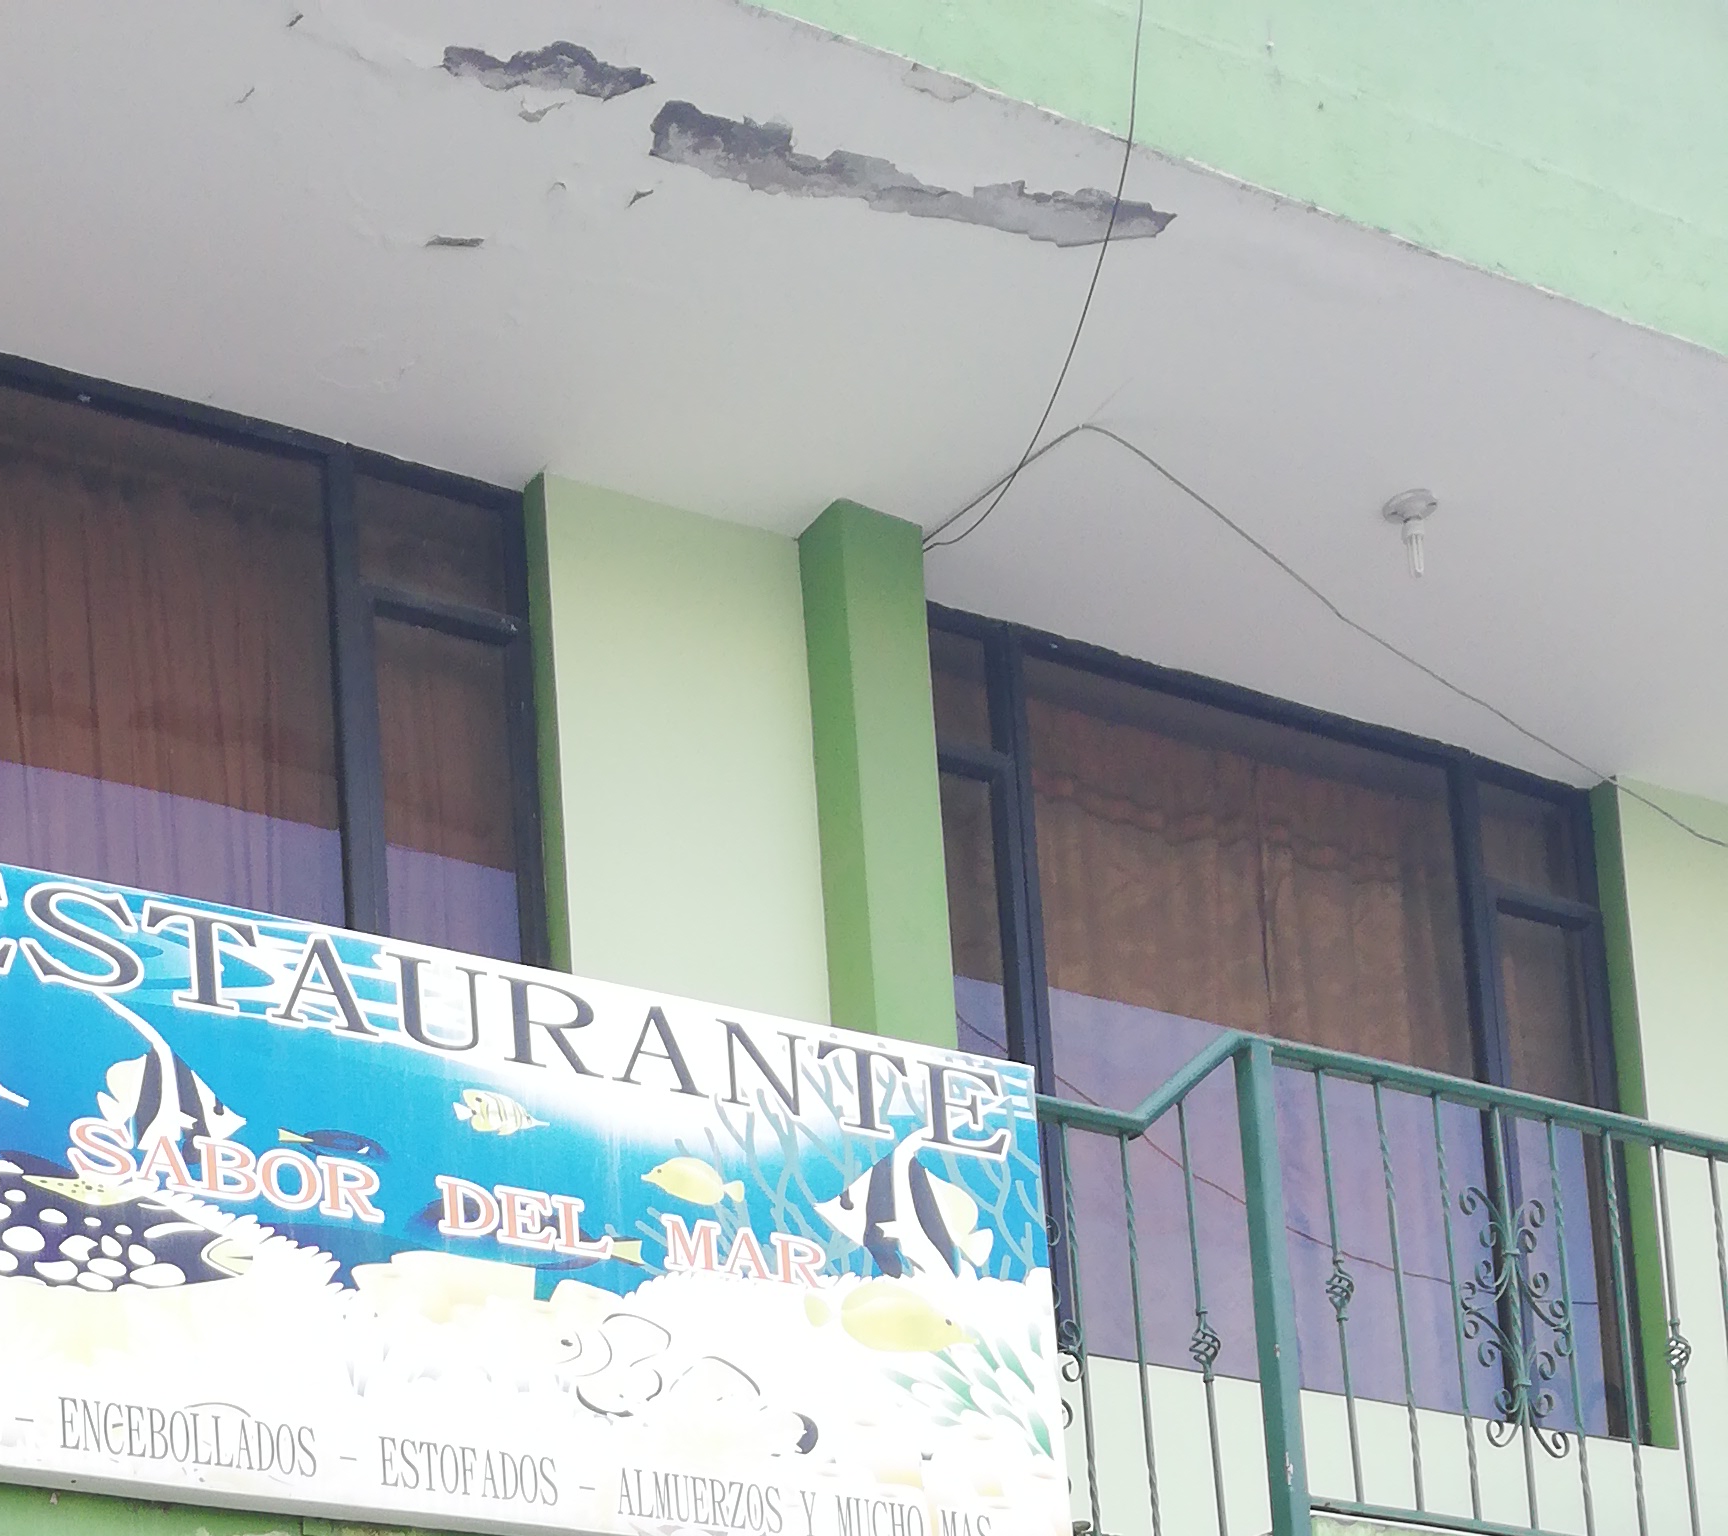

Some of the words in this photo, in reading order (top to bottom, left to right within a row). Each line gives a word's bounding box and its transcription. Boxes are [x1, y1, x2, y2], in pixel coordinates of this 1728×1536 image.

[70, 1118, 382, 1222] SABOR
[436, 1176, 614, 1258] DEL
[666, 1214, 828, 1289] MAR
[57, 1396, 318, 1479] ENCEBOLLADOS
[377, 1435, 559, 1507] ESTOFADOS
[617, 1467, 784, 1535] ALMUERZOS
